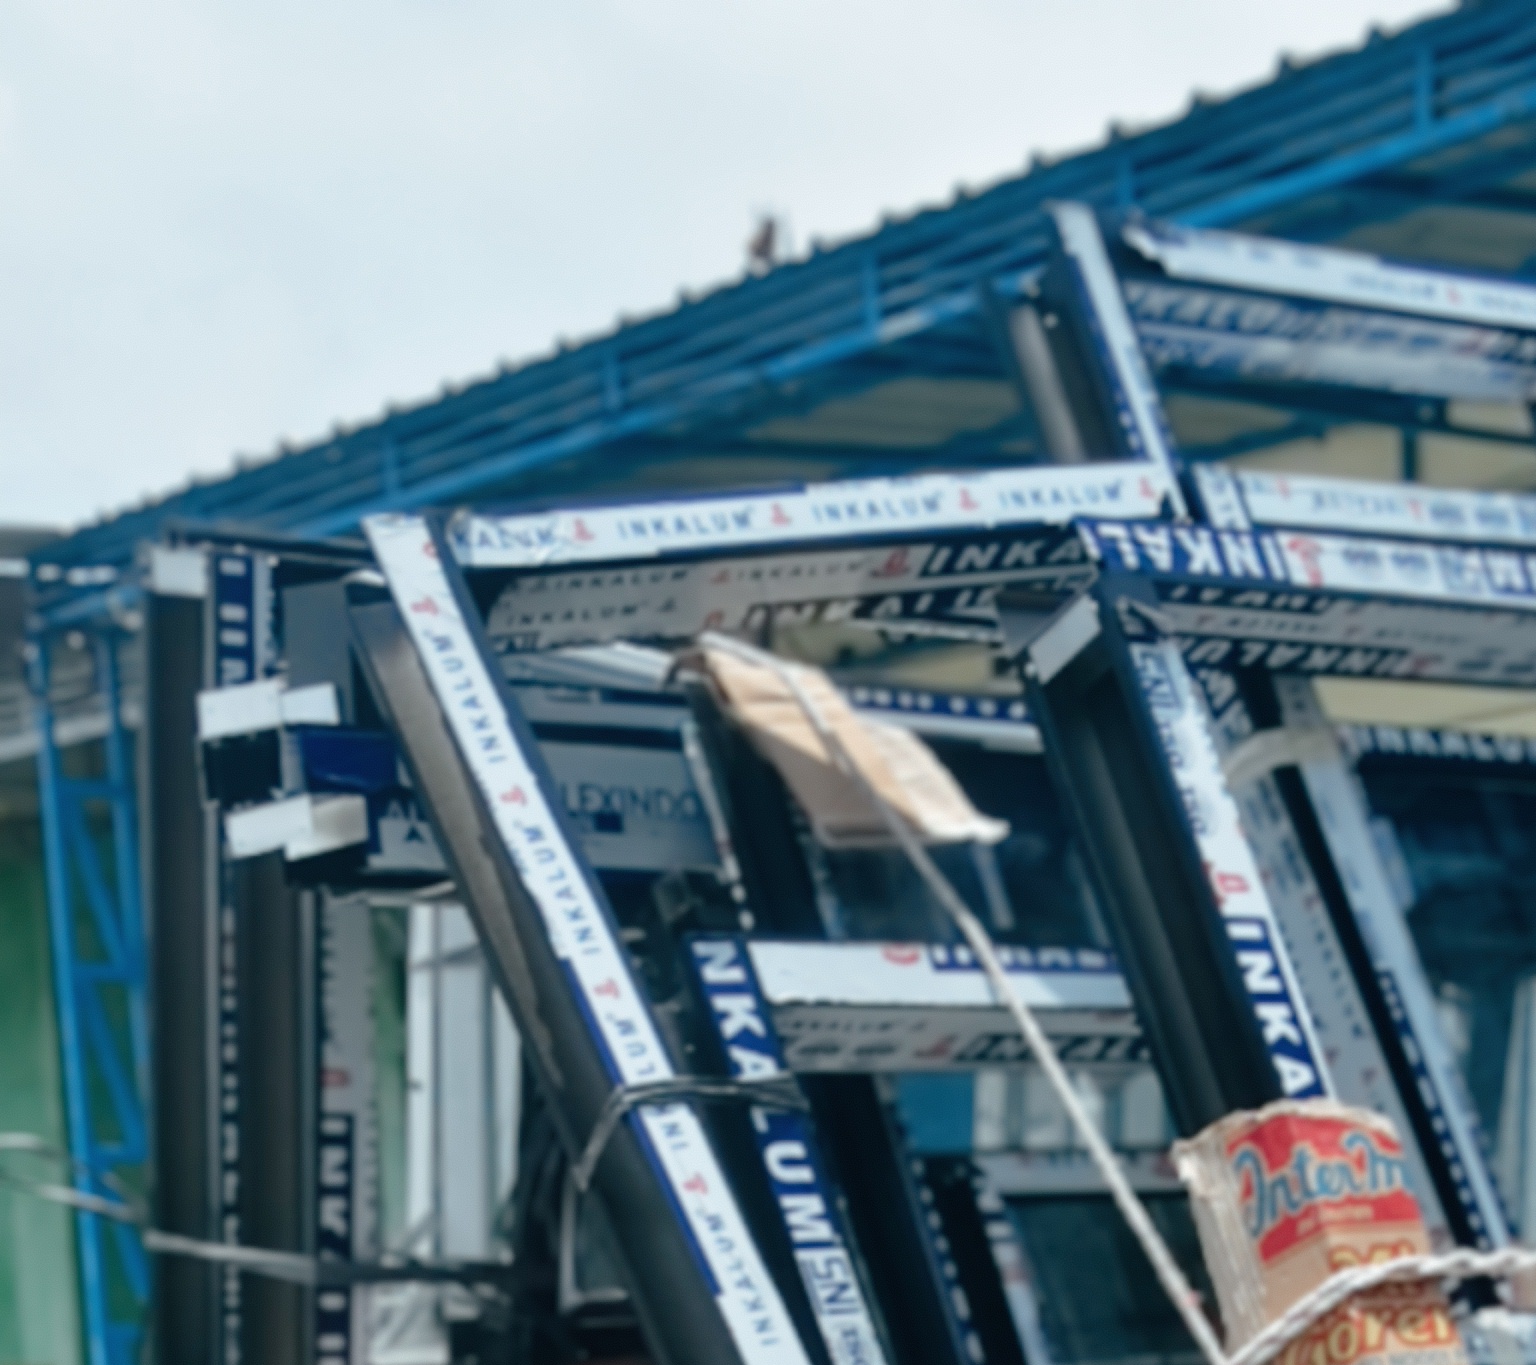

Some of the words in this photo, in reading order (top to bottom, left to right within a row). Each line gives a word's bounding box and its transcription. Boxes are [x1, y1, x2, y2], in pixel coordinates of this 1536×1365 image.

[452, 518, 554, 552] KALUM
[616, 505, 752, 542] INKALUM
[810, 492, 943, 524] INKALUM
[1000, 479, 1125, 510] INKALUM
[928, 533, 1083, 577] INKA
[424, 628, 509, 764] INKALUM
[517, 820, 601, 957] INKALUM
[611, 1012, 692, 1174] INLUM
[704, 1210, 781, 1350] INKALUM
[1227, 920, 1319, 1098] INKA
[691, 940, 841, 1250] NKALUM
